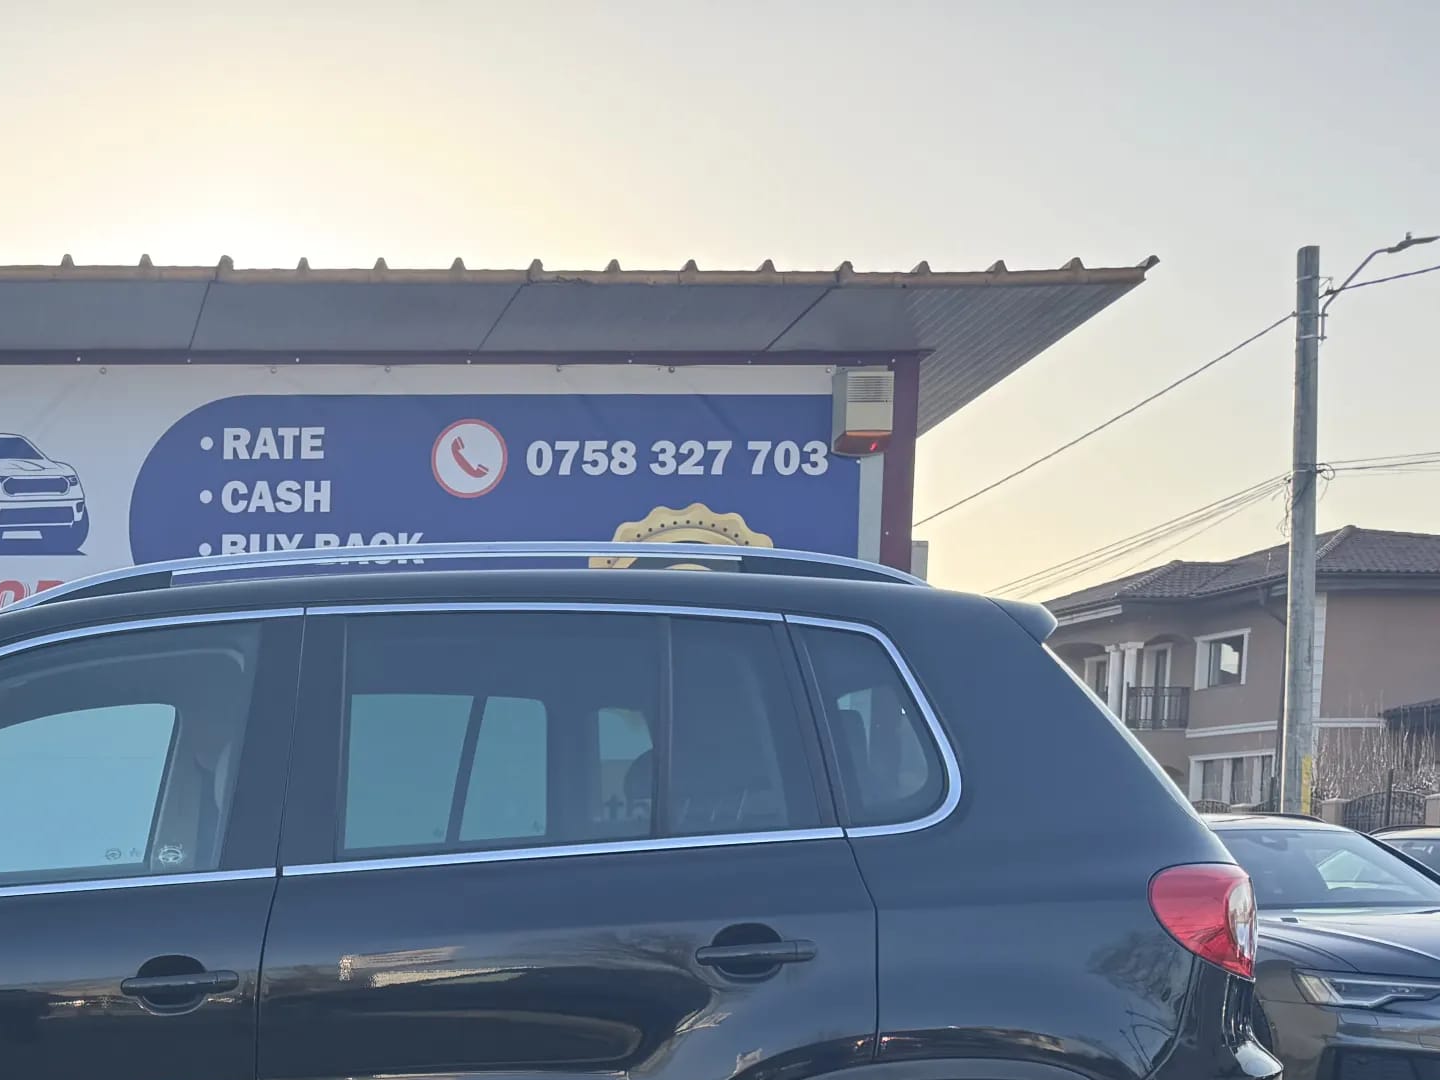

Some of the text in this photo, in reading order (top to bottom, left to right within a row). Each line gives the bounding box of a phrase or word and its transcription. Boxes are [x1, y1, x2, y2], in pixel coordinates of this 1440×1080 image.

[223, 427, 325, 460] RATE
[526, 440, 829, 476] 0758 327 703
[221, 480, 331, 513] CASH
